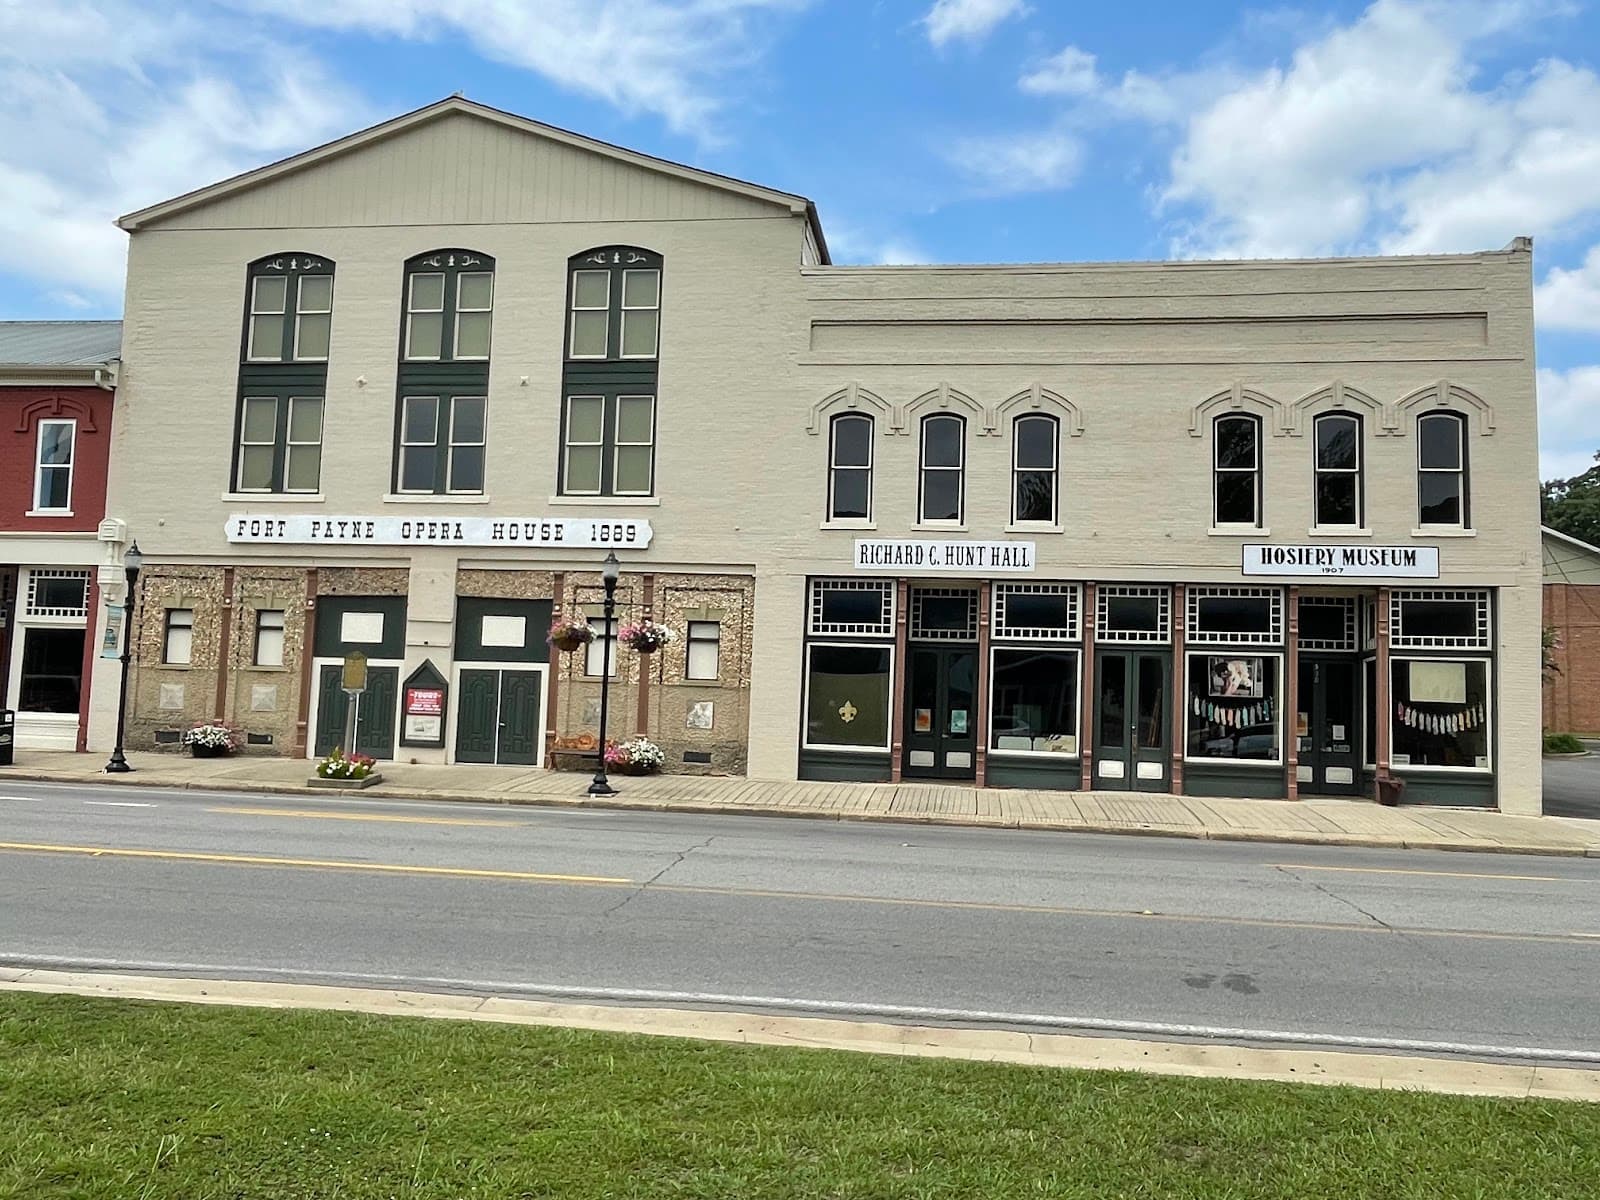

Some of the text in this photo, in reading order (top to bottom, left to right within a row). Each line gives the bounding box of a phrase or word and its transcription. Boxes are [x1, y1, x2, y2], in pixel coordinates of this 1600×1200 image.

[237, 520, 636, 542] FORT PAYNE OPERA HOUSE 1889
[859, 543, 1030, 568] RICHARD C. HUNT HALL
[1260, 547, 1417, 567] HOSIERY MUSEUM
